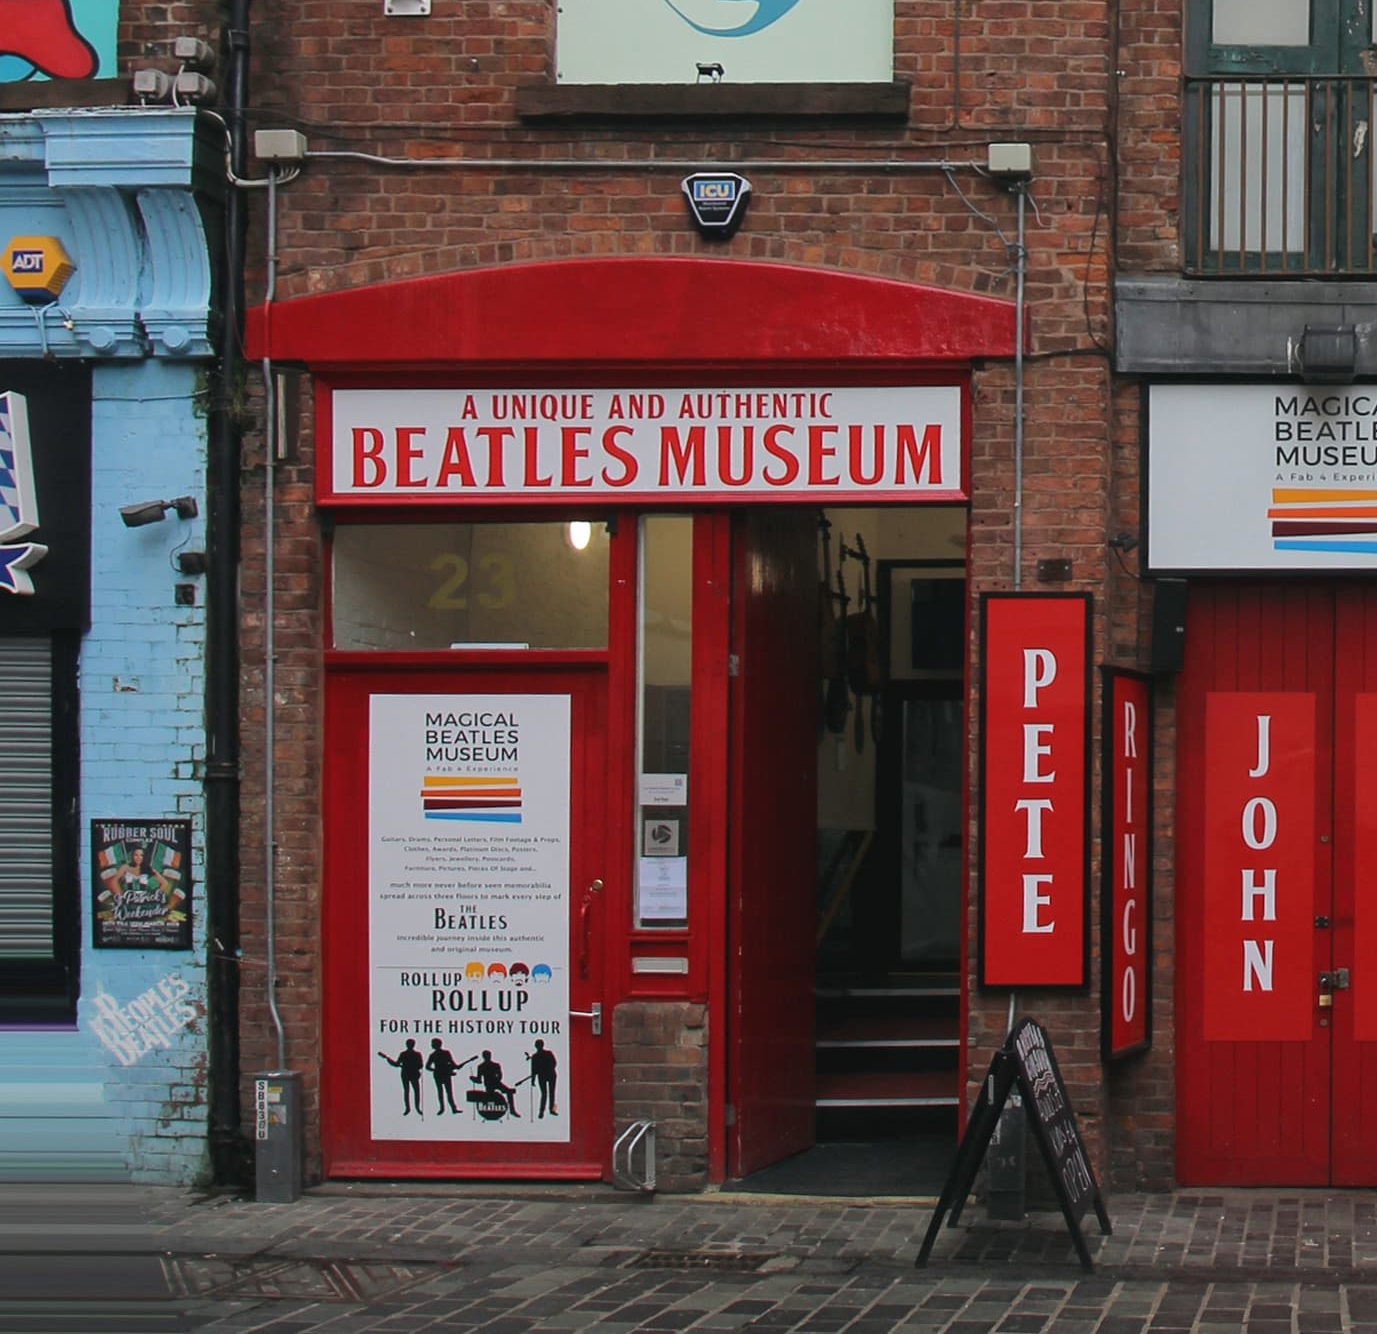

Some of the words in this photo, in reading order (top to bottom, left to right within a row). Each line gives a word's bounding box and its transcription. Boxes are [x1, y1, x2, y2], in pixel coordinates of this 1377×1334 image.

[699, 184, 730, 198] ICU
[13, 253, 45, 270] ADT
[461, 394, 478, 420] A
[491, 394, 594, 422] UNIQUE
[607, 394, 665, 420] AND
[678, 391, 833, 420] AUTHENTIC
[351, 424, 639, 488] BEATLES
[657, 423, 943, 487] MUSEUM
[1275, 473, 1283, 481] A
[1290, 473, 1313, 481] Fab
[1319, 473, 1326, 481] 4
[426, 551, 518, 610] 23
[426, 713, 519, 727] MAGICAL
[426, 730, 519, 744] BEATLES
[426, 747, 518, 761] MUSEUM
[1014, 648, 1057, 934] PETE
[103, 827, 147, 843] RUBBER
[149, 827, 179, 843] SOUL
[1241, 715, 1278, 992] JOHN
[1122, 701, 1137, 1023] RINGO
[390, 881, 411, 889] much
[457, 881, 482, 889] before
[504, 881, 552, 889] memorabilia
[460, 905, 477, 913] THE
[401, 972, 439, 986] ROLL
[443, 972, 462, 986] UP
[432, 990, 492, 1011] ROLL
[499, 990, 529, 1012] UP
[380, 1019, 409, 1033] FOR
[413, 1020, 443, 1033] THE
[449, 1020, 514, 1034] HISTORY
[520, 1021, 561, 1034] TOUR
